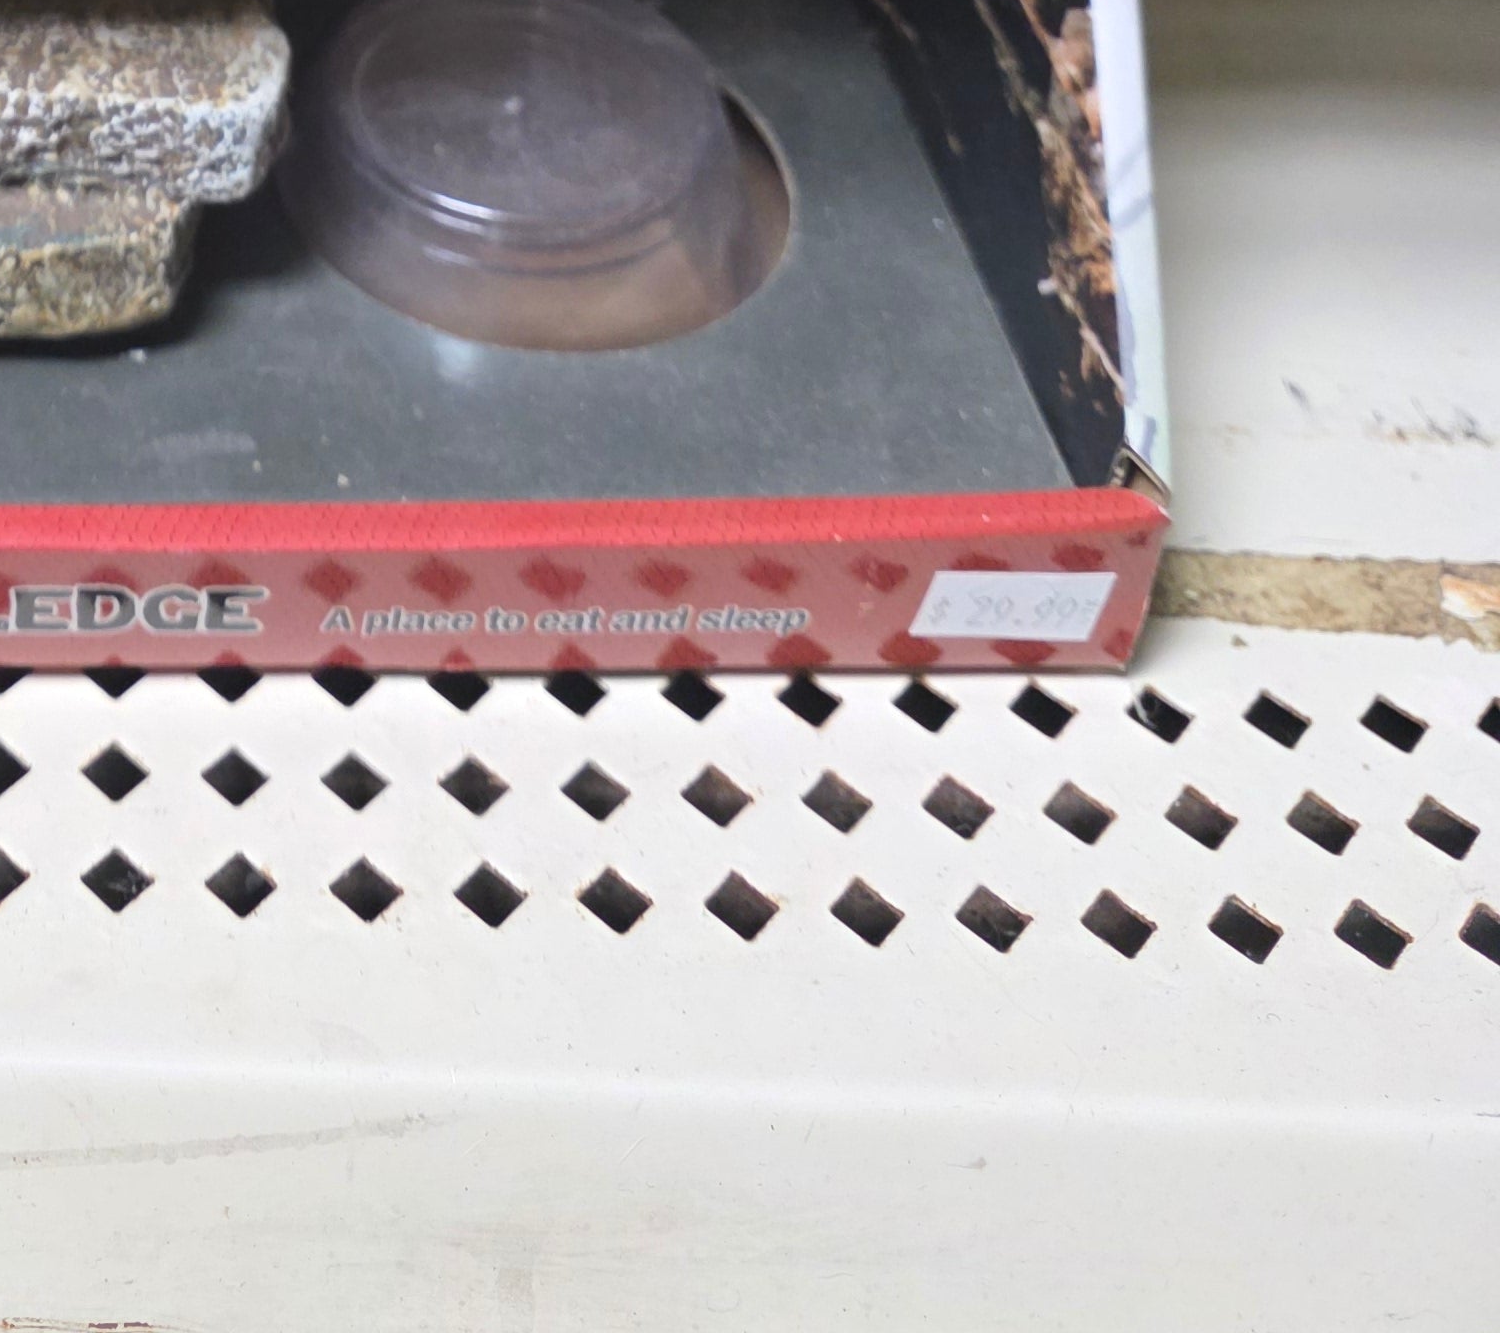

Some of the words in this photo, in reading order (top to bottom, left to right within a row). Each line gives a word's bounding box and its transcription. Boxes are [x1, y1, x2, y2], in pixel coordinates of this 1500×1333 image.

[320, 604, 354, 632] A
[362, 605, 475, 637] place
[484, 606, 527, 632] to
[534, 606, 604, 633] eat
[610, 604, 691, 633] and
[696, 604, 810, 637] sleep
